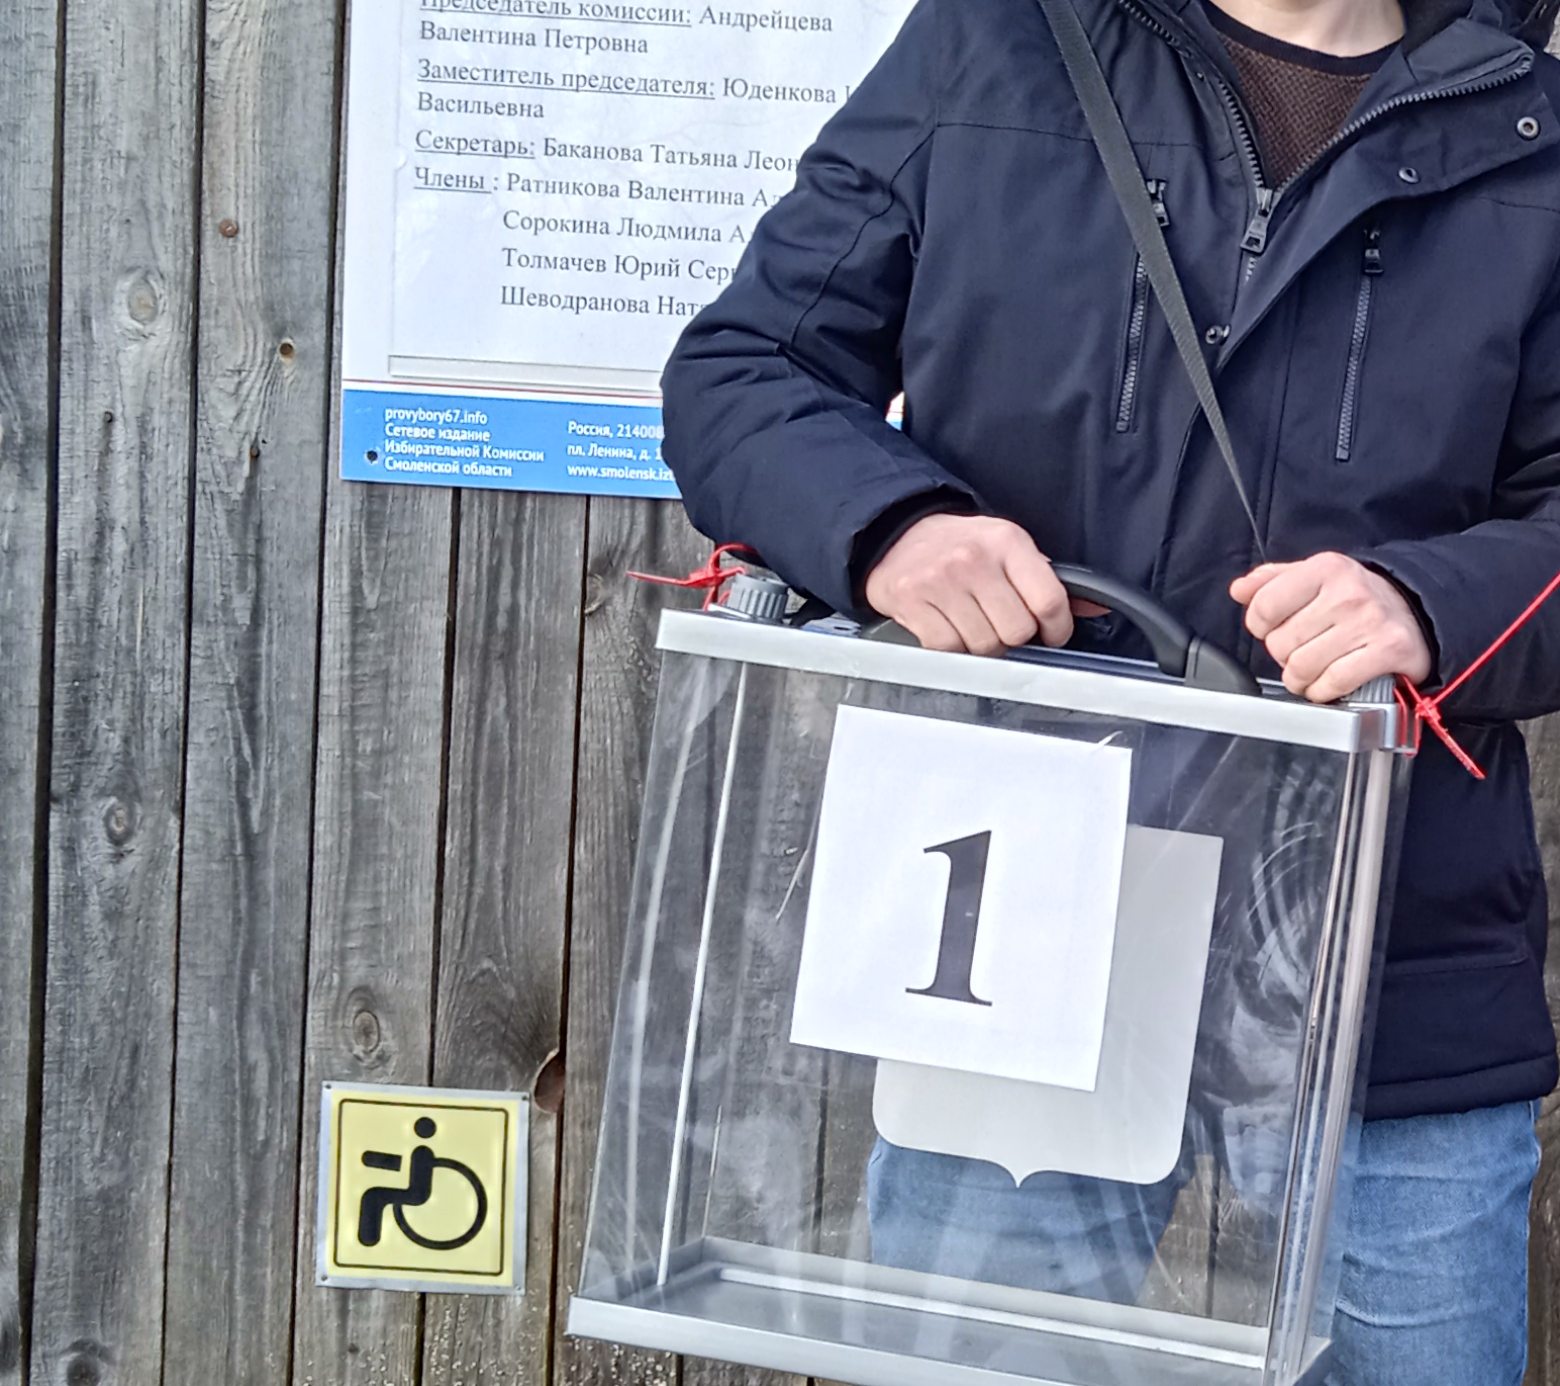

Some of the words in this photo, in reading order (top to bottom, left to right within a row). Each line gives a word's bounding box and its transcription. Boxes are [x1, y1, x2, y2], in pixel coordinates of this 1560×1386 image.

[578, 2, 692, 25] комиссии:
[699, 6, 832, 33] Андрейцева
[420, 21, 536, 48] Валентина
[545, 29, 648, 55] Петровна
[417, 59, 554, 86] Заместитель
[562, 71, 715, 98] председателя:
[722, 76, 836, 104] Юденкова
[418, 92, 545, 118] Васильевна
[415, 130, 535, 157] Секретарь:
[543, 138, 643, 163] Баканова
[651, 144, 737, 170] Татьяна
[414, 167, 485, 190] Члены
[507, 173, 620, 199] Ратникова
[628, 181, 745, 206] Валентина
[502, 210, 610, 237] Сорокина
[616, 217, 722, 244] Людмила
[502, 248, 607, 274] Толмачев
[614, 255, 681, 280] Юрий
[501, 286, 650, 316] Шеводранова
[385, 408, 487, 424] provybory67.info
[568, 420, 613, 438] Россия,
[385, 423, 435, 439] Сетевое
[439, 429, 491, 442] издание
[385, 439, 479, 457] Избирательной
[483, 446, 544, 462] Комиссии
[567, 445, 585, 456] пл.
[588, 443, 636, 460] Ленина,
[639, 449, 651, 461] д.
[385, 457, 459, 474] Смоленской
[463, 464, 512, 477] области
[904, 830, 994, 1007] 1
